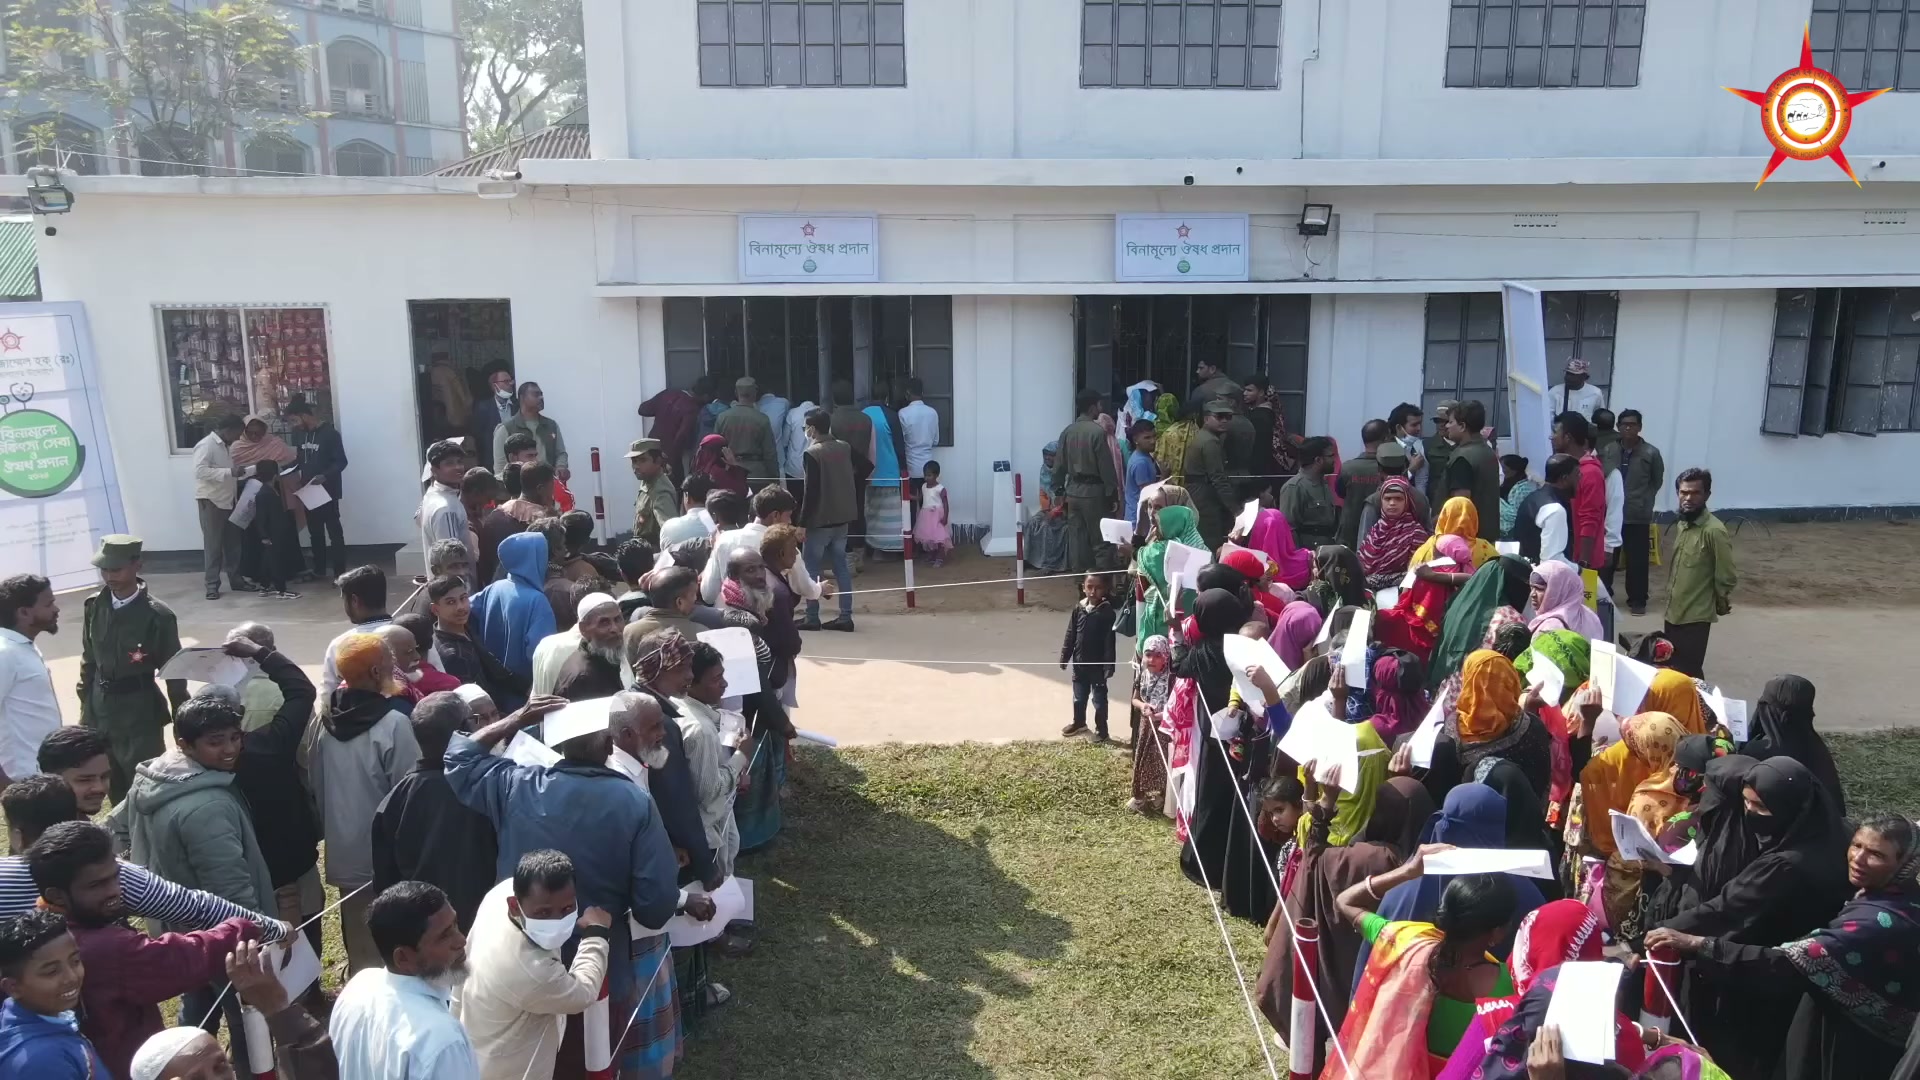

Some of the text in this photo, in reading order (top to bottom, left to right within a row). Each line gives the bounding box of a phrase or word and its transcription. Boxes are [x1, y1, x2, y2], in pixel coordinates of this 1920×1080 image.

[749, 239, 870, 259] বিনামূল্যে ঔষধ প্রদান
[1126, 240, 1241, 260] বিনামূল্যে ঔষধ প্রদান
